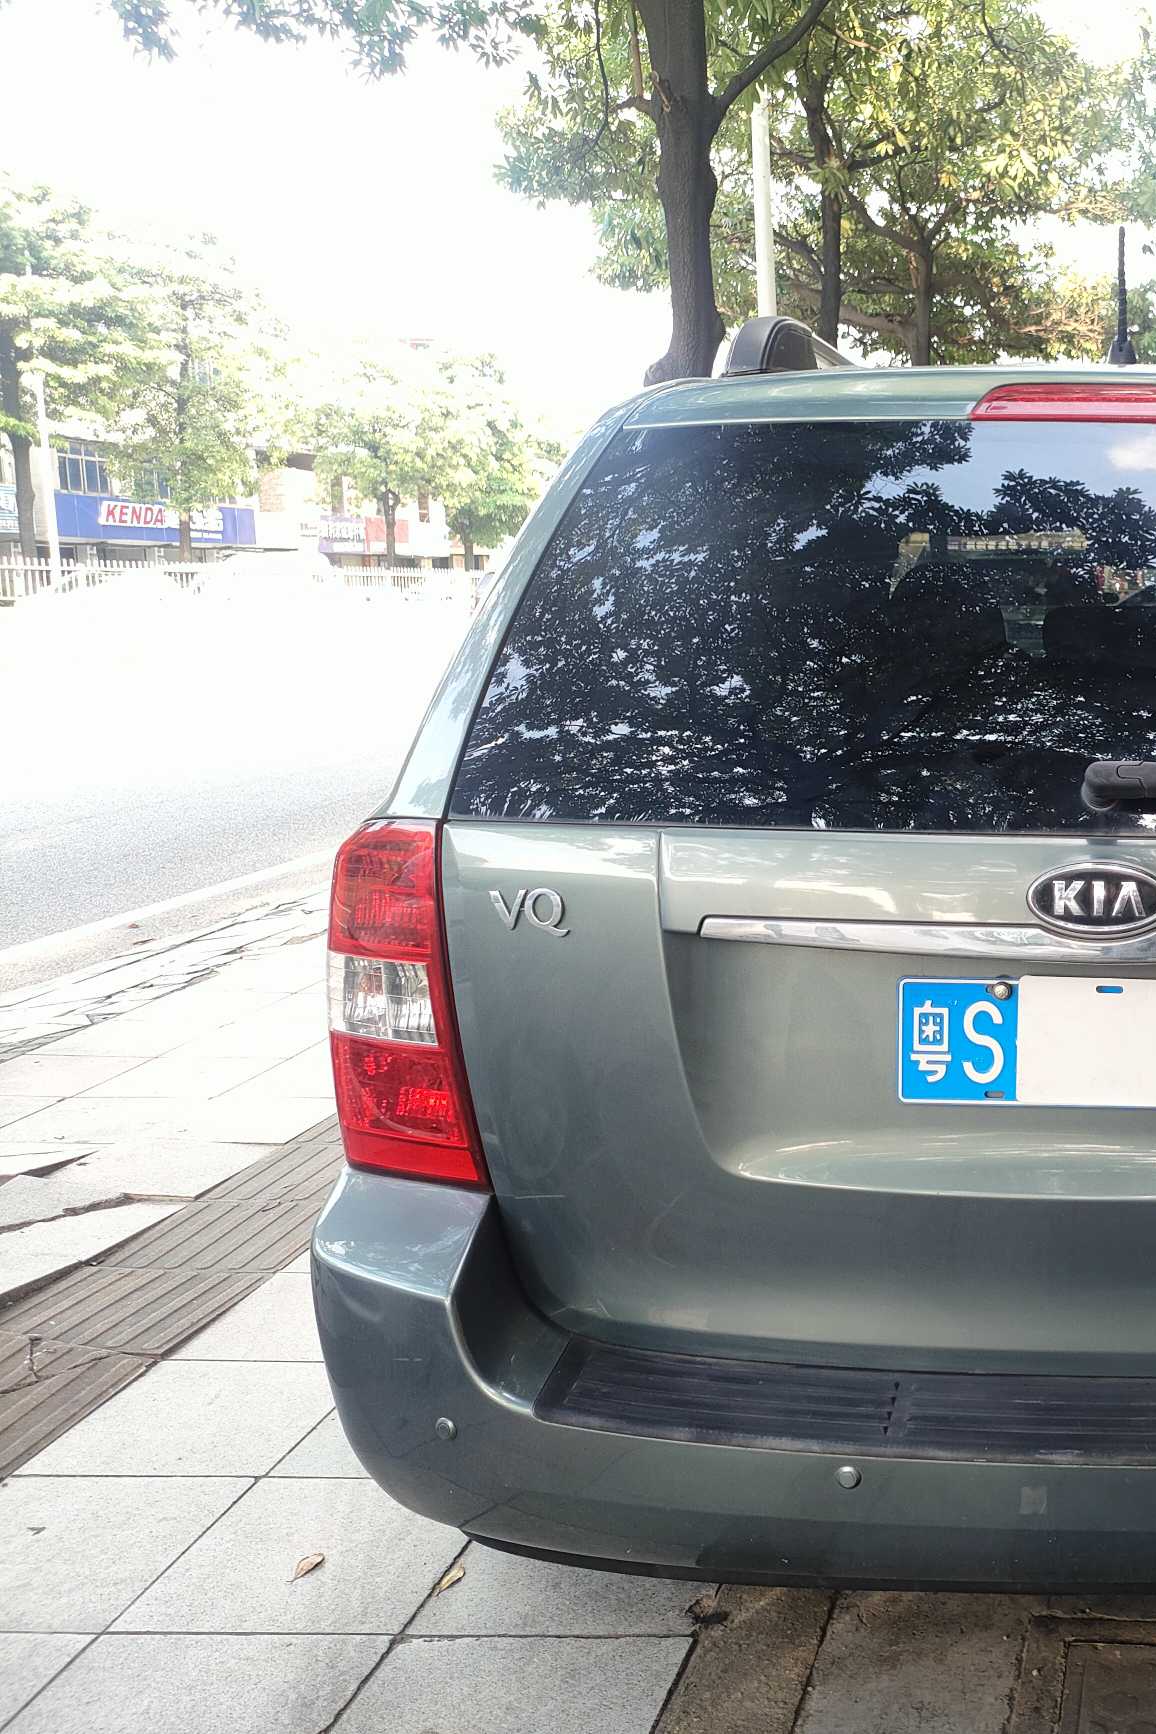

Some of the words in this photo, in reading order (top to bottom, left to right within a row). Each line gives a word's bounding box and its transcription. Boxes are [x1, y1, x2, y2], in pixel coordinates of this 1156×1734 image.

[105, 503, 165, 526] KENDA
[488, 888, 569, 937] VQ
[1052, 880, 1146, 917] KIA
[910, 1000, 1005, 1084] 粤S
